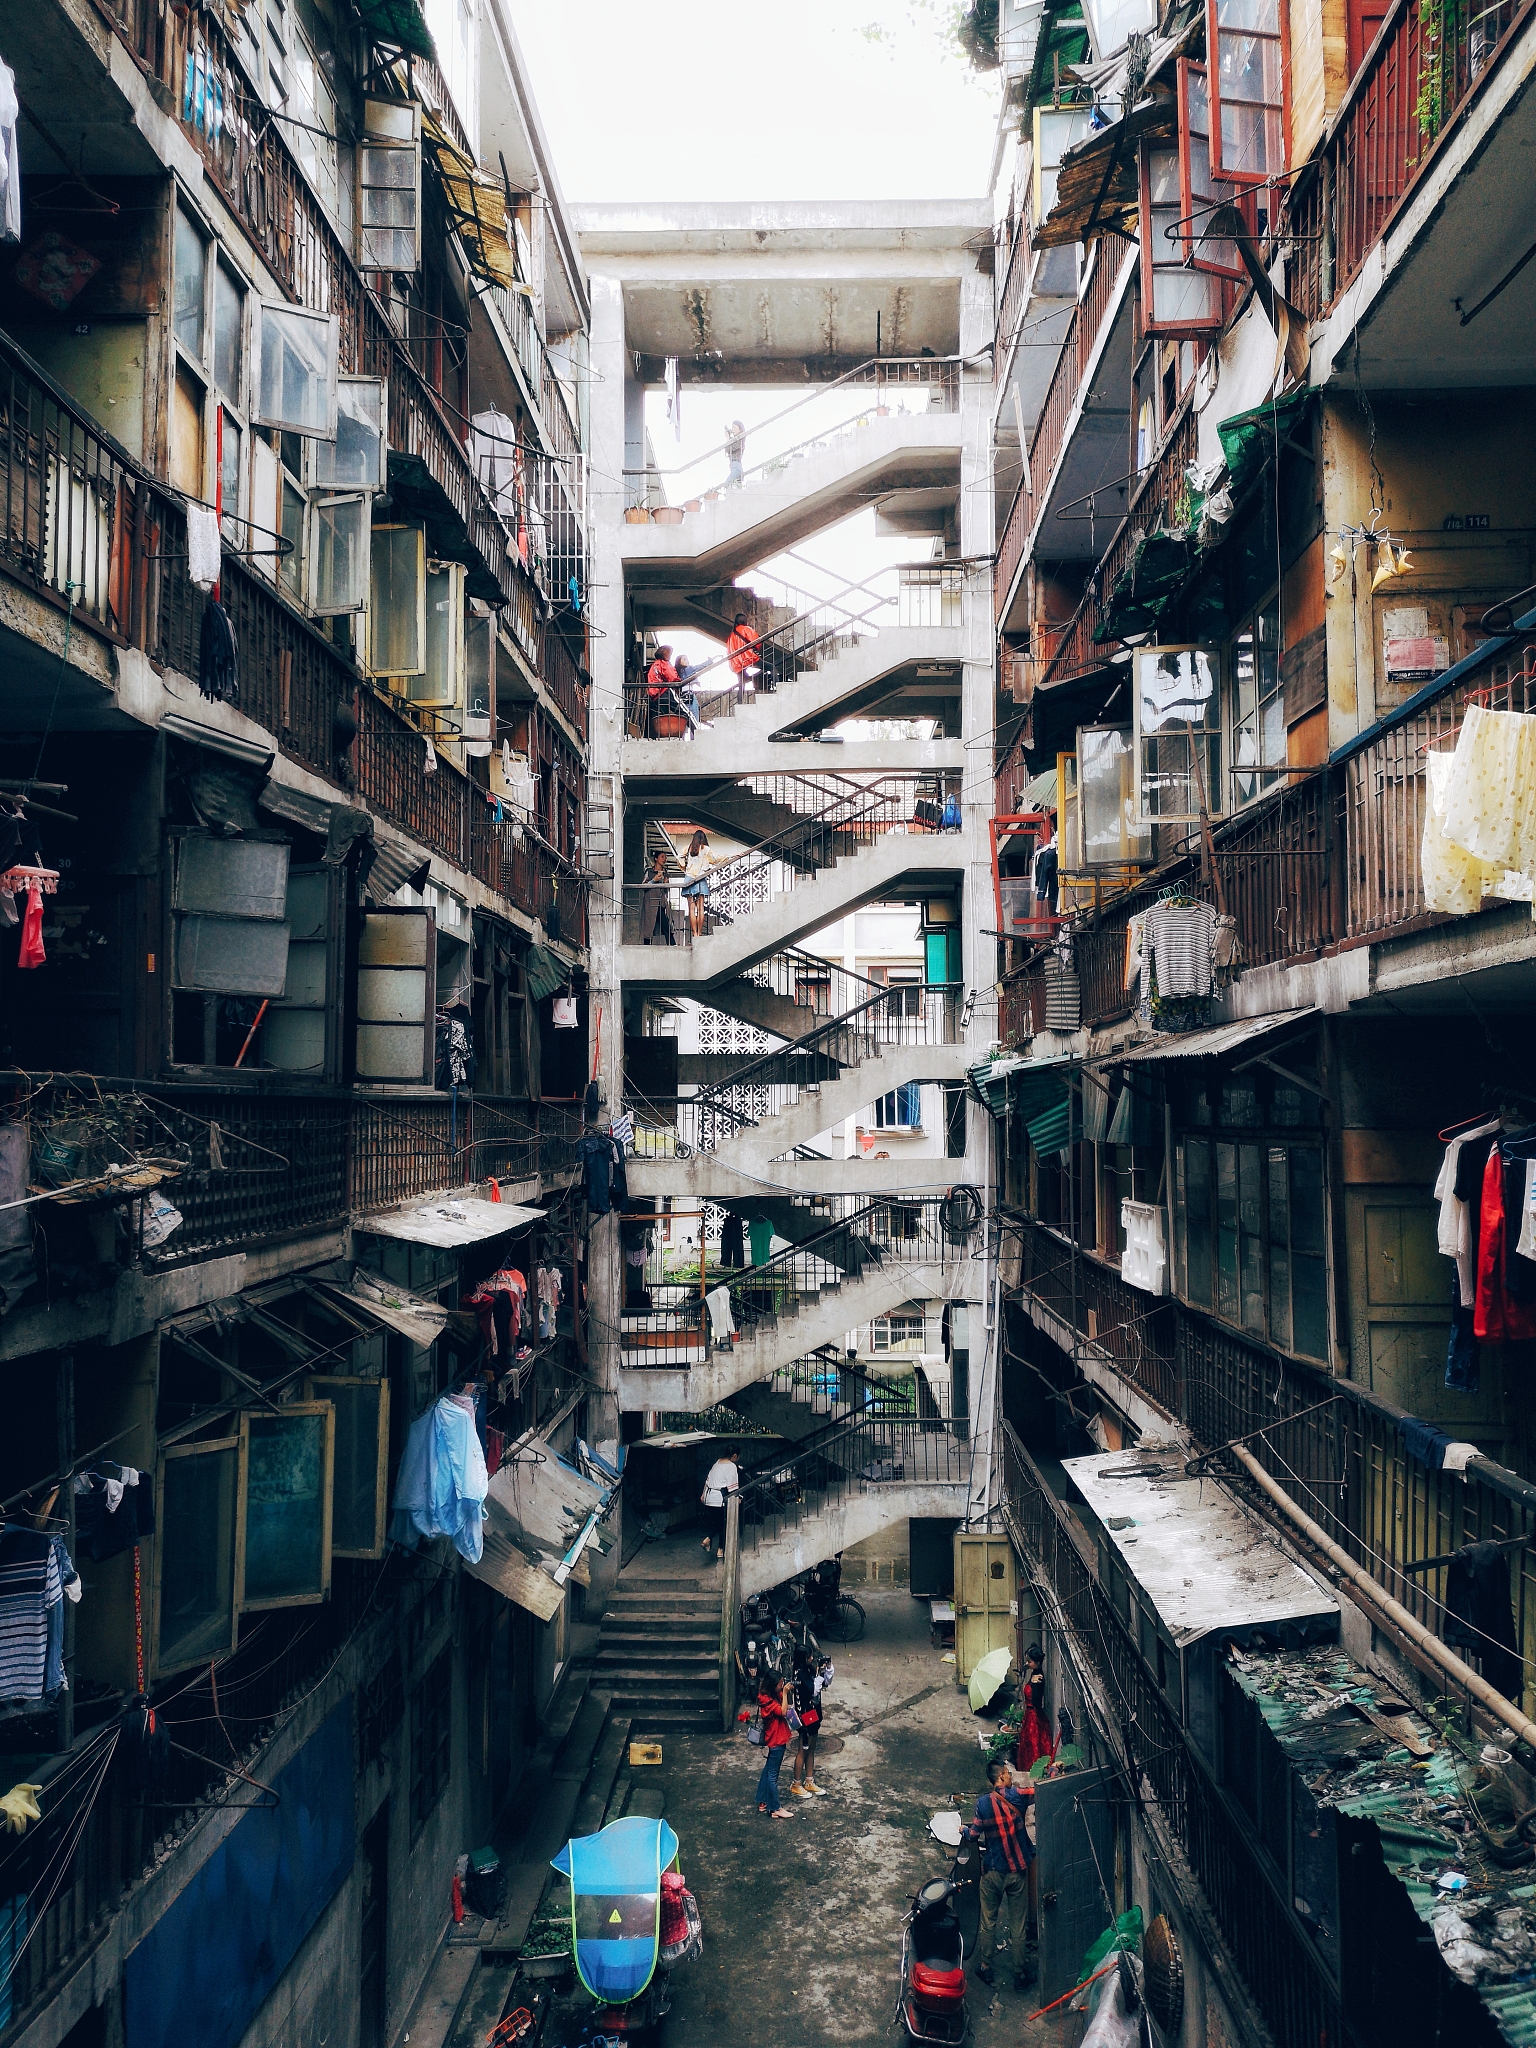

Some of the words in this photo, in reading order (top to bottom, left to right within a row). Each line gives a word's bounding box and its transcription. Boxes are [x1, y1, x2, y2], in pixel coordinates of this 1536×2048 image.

[75, 325, 89, 334] 42
[1468, 516, 1488, 526] 114
[58, 858, 72, 868] 30
